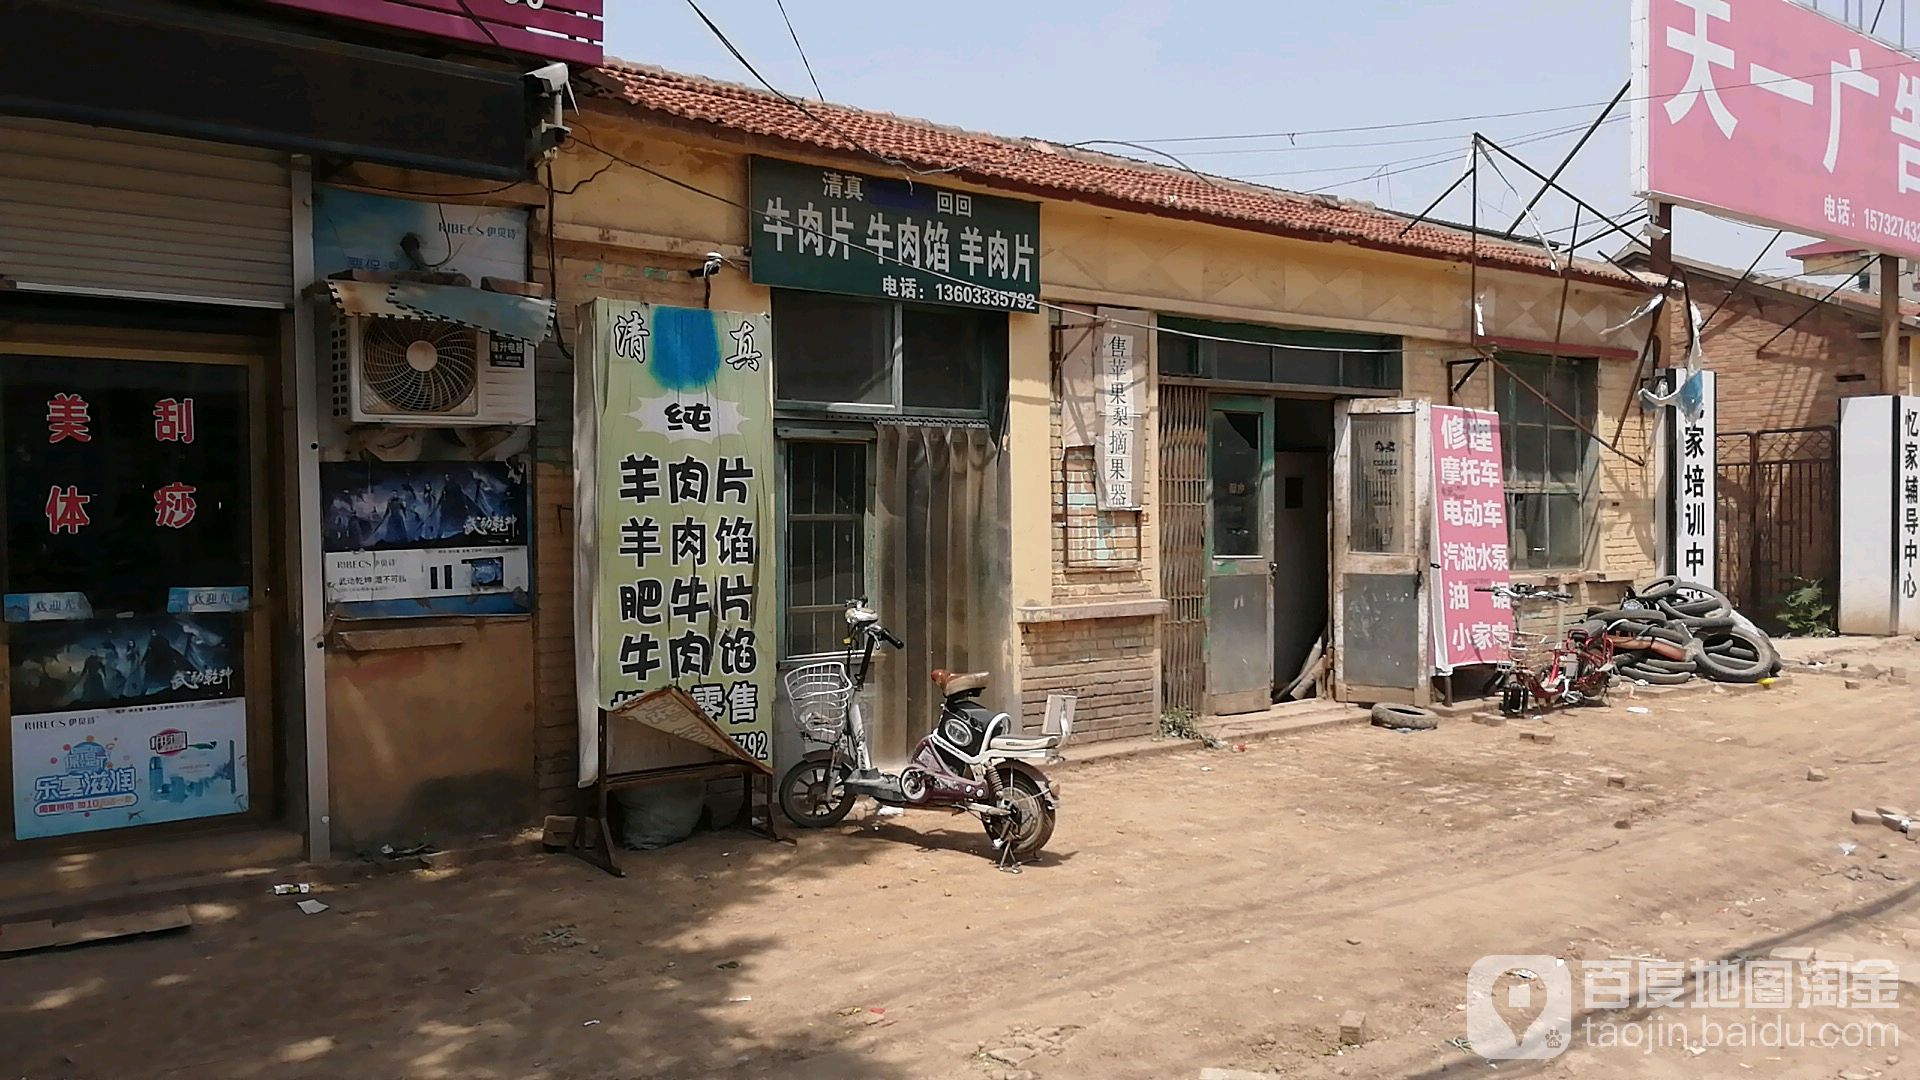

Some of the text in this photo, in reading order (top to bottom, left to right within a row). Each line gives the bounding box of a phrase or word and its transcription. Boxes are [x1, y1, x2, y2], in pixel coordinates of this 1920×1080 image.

[1664, 0, 1920, 194] 天一广告
[822, 170, 972, 217] 清真 回回
[763, 197, 1035, 282] 牛肉片 牛肉馅 羊肉片
[664, 402, 711, 432] 纯
[1108, 335, 1129, 506] 售苹果梨摘果器
[1441, 414, 1493, 453] 修理
[619, 454, 754, 503] 羊肉片
[1441, 456, 1500, 488] 摩托车
[1443, 498, 1503, 528] 电动车
[1903, 408, 1919, 599] 忆家辅导中心
[619, 517, 754, 568] 羊肉馅
[1443, 542, 1509, 572] 汽油水泵
[619, 575, 753, 623] 肥牛片
[619, 627, 757, 681] 牛肉馅
